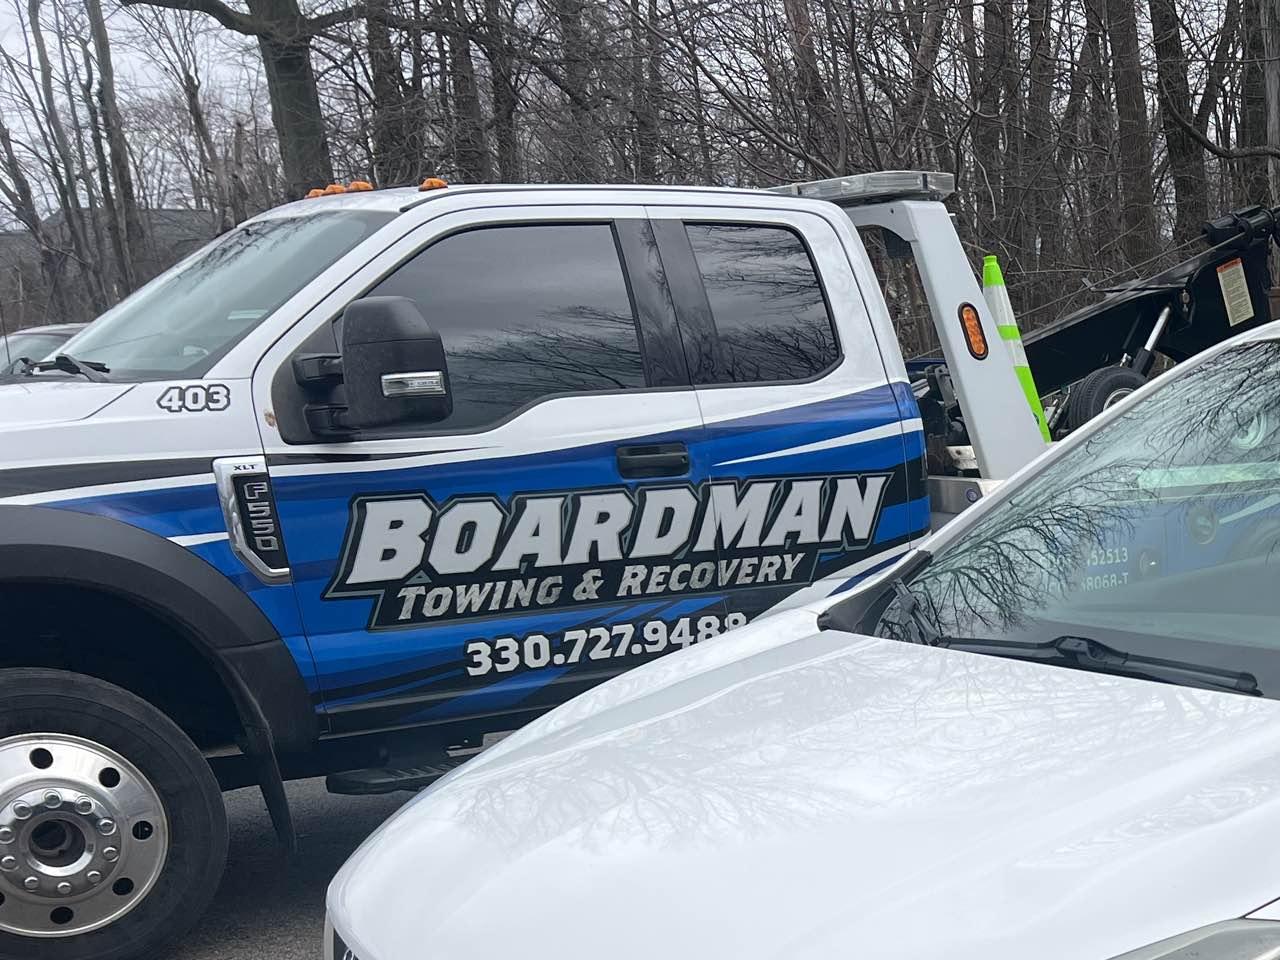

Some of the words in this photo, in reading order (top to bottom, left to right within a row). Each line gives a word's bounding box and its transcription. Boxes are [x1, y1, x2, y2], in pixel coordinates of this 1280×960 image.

[157, 384, 231, 413] 403
[244, 481, 280, 551] F550
[345, 476, 887, 584] BOARDMAN
[397, 575, 562, 620] TOWING
[573, 568, 605, 601] &
[617, 552, 806, 597] RECOVERY
